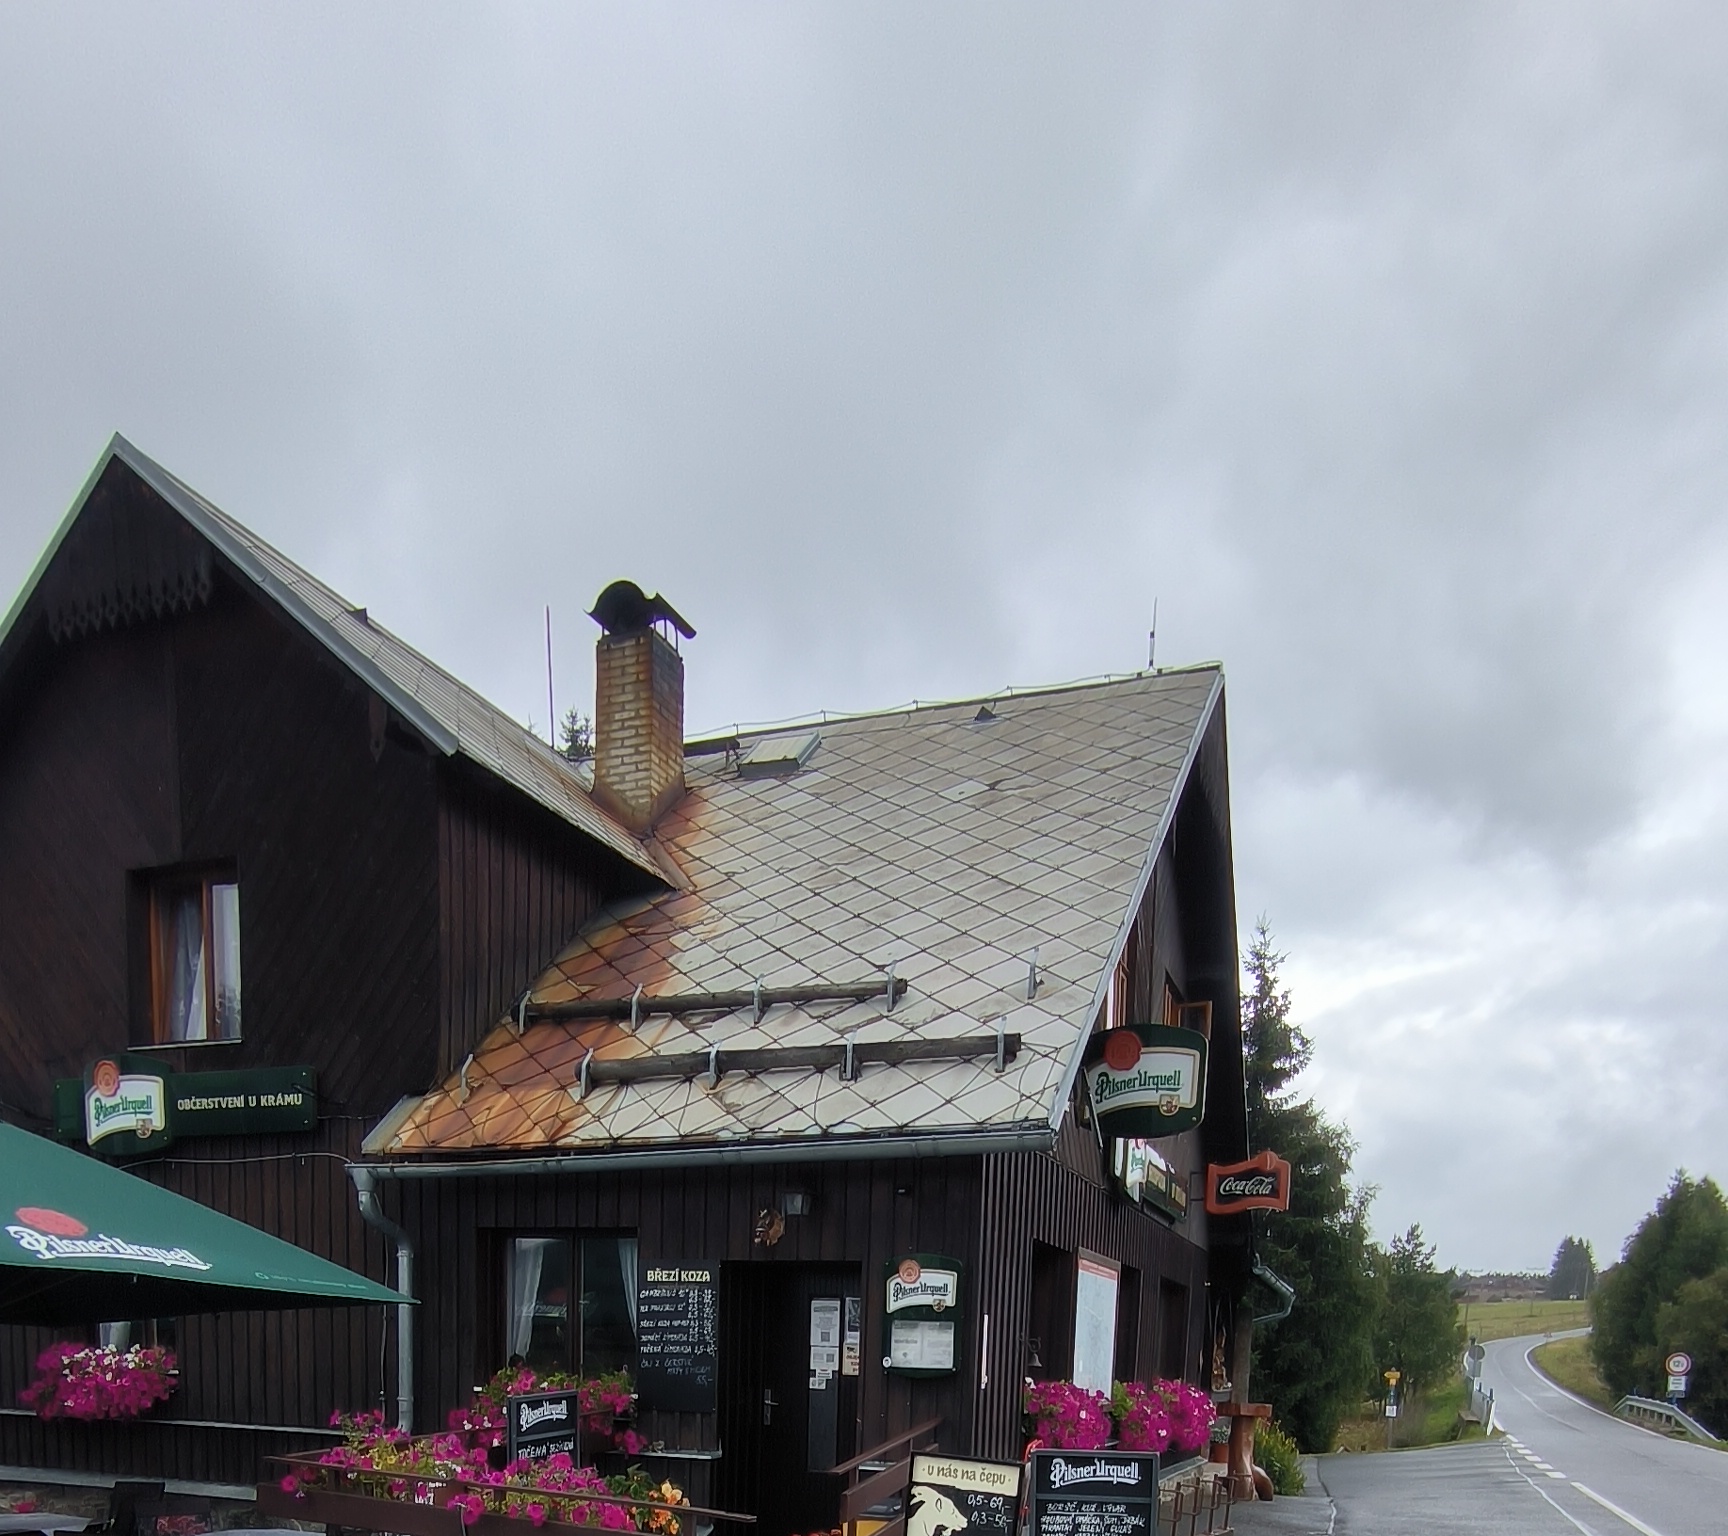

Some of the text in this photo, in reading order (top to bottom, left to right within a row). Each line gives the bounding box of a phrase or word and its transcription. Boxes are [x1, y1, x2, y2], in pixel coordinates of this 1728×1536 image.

[1095, 1069, 1181, 1104] Pilsner Urquell
[94, 1095, 152, 1127] Pilsner Urquell
[177, 1092, 303, 1111] OBČERSTVENÍ U KRÁMU
[1219, 1176, 1275, 1195] Coca-Cola
[5, 1225, 206, 1267] Pilsner Urquell
[647, 1267, 711, 1282] BŘEZÍ KOZA
[893, 1281, 949, 1302] Pilsner Urquell
[520, 1400, 568, 1432] Pilsner Urquell
[936, 1463, 958, 1480] nás
[961, 1468, 976, 1481] na
[979, 1467, 1006, 1487] čepu
[1050, 1457, 1139, 1489] Pilsner Urquell
